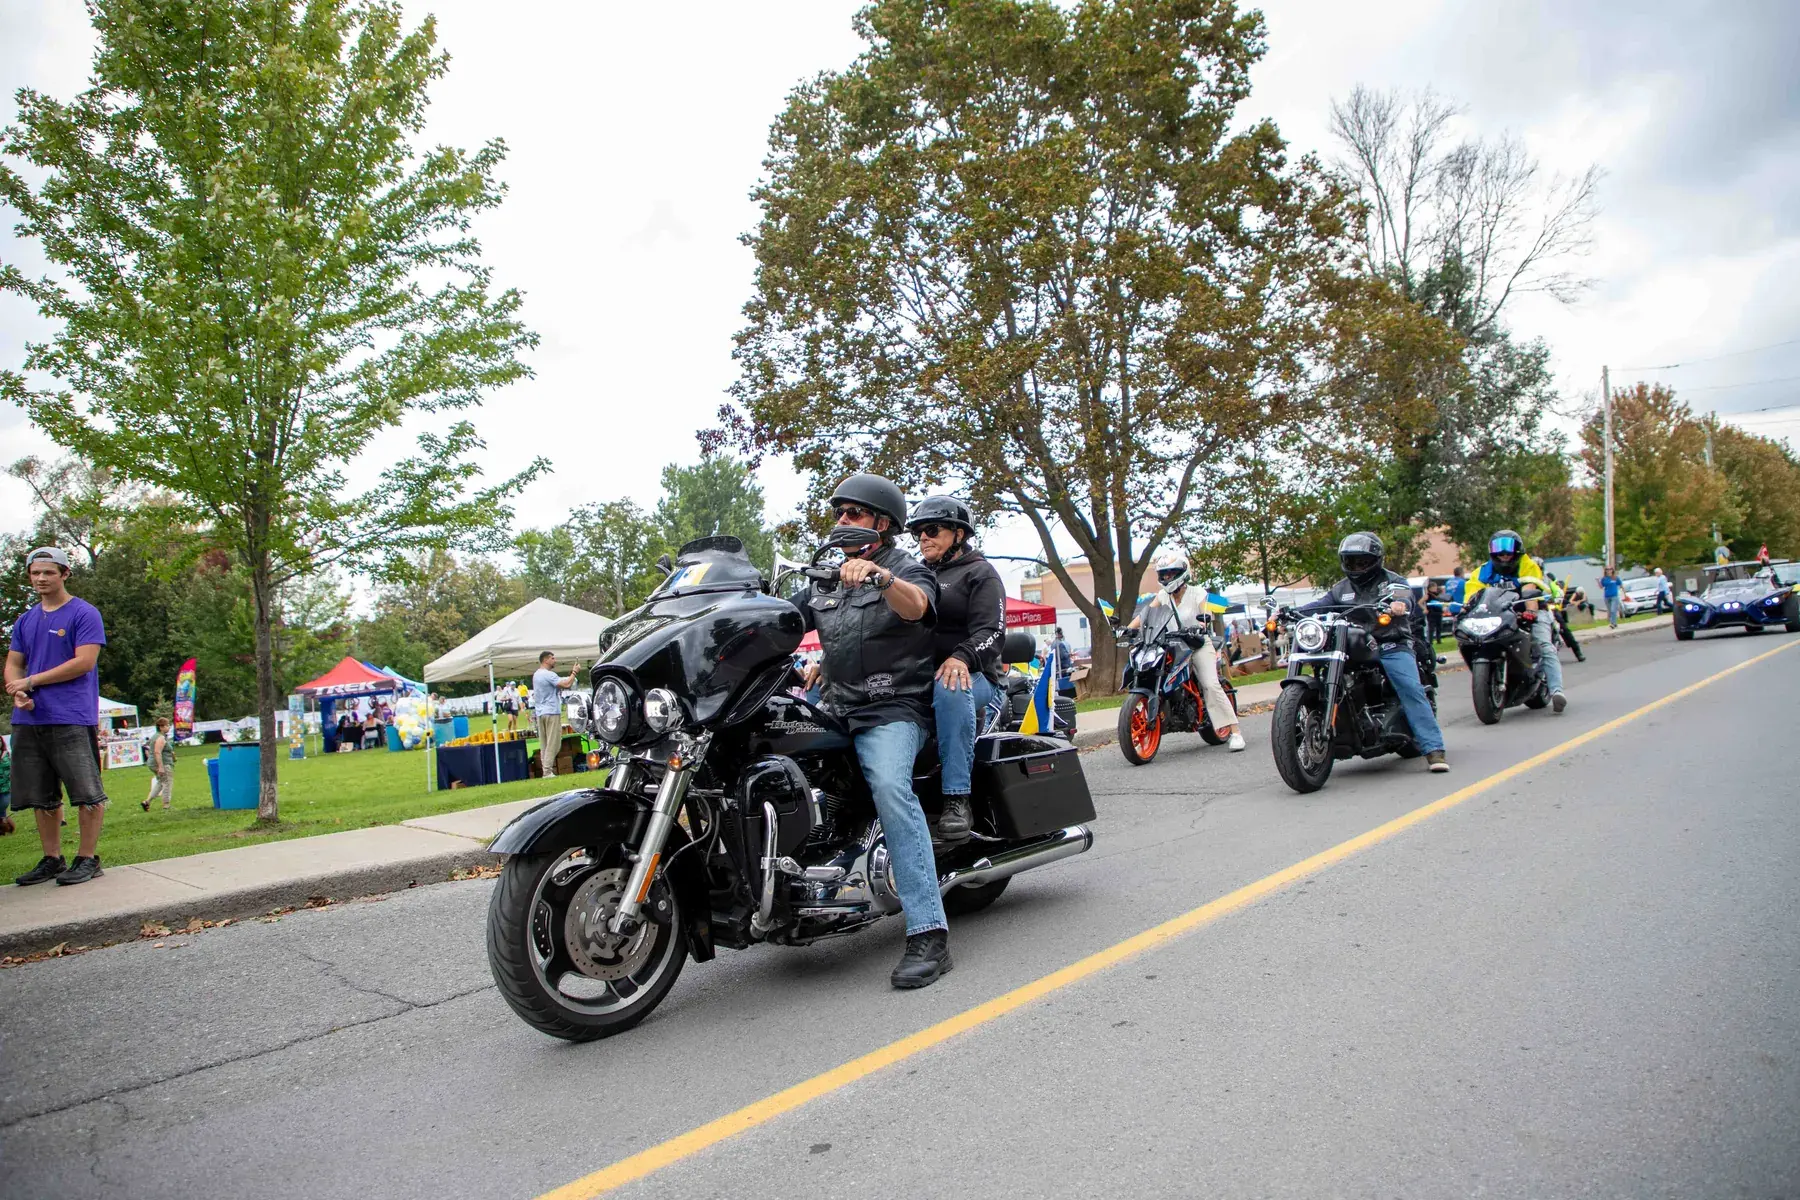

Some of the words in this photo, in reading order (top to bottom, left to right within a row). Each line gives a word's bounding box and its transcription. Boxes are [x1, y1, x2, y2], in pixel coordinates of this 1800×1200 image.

[1005, 613, 1021, 624] eton
[1022, 612, 1042, 622] Place
[312, 681, 377, 696] TREK
